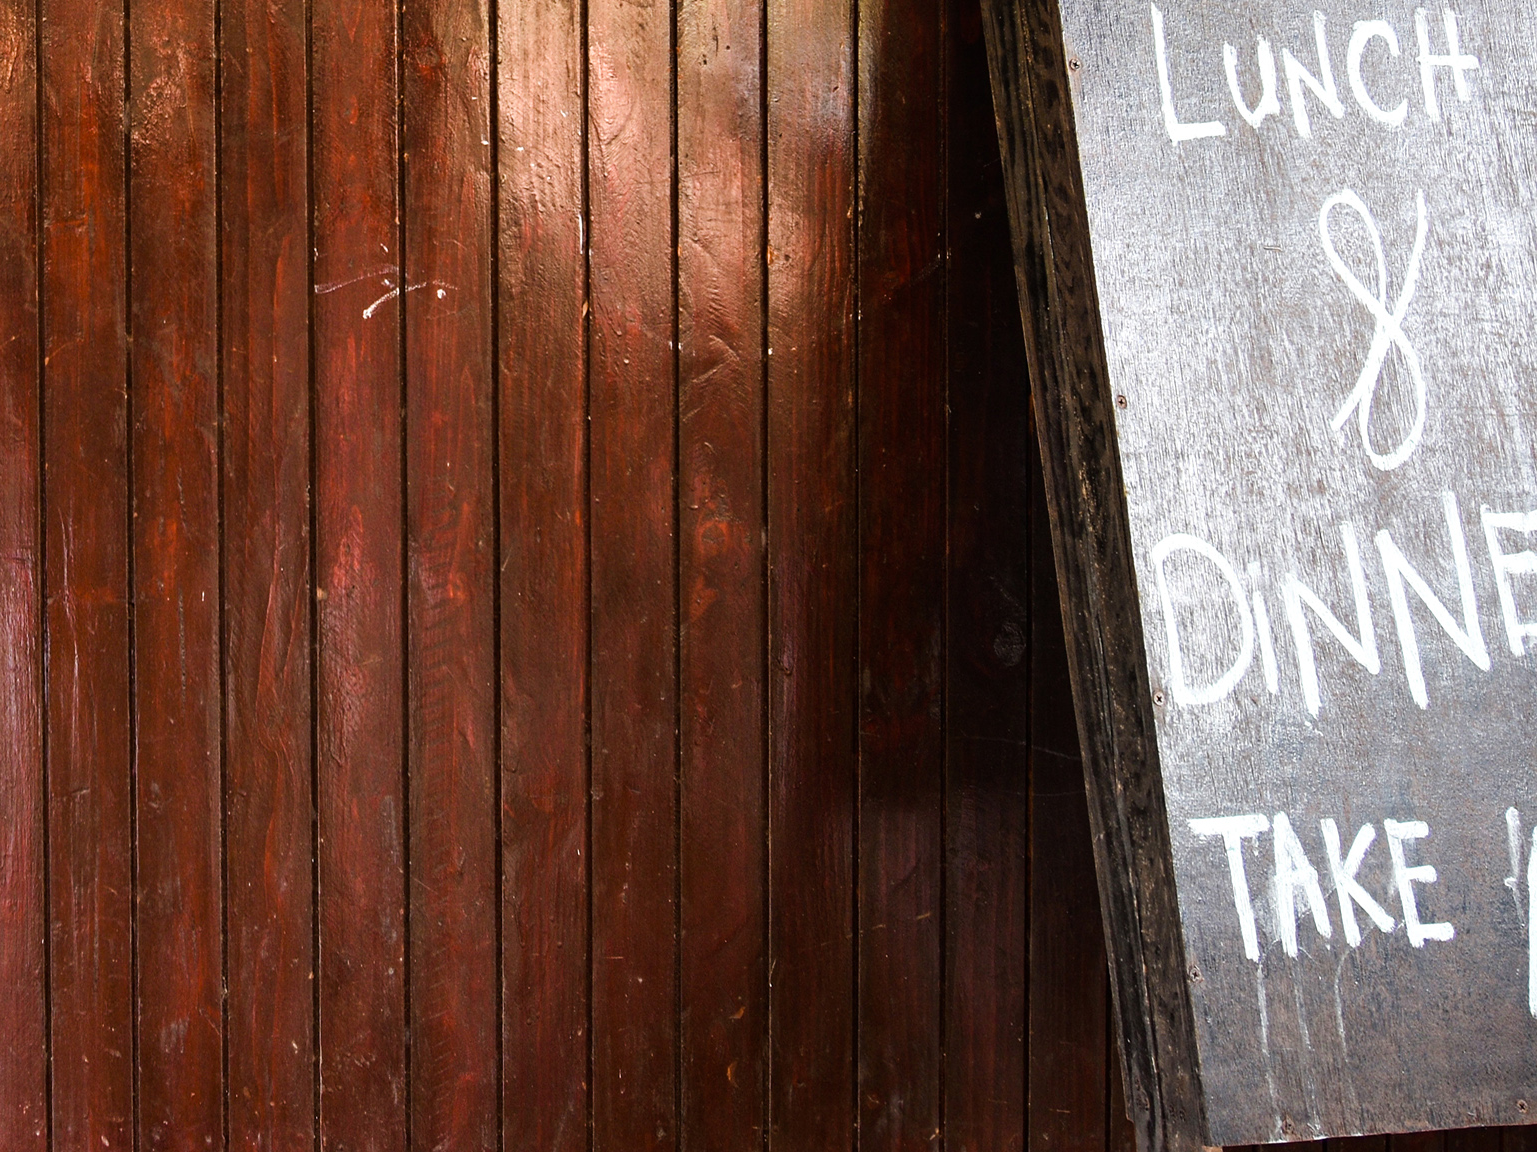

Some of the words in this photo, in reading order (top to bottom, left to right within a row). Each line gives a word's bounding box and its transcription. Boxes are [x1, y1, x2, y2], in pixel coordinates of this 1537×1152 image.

[1150, 0, 1480, 144] LUNCH
[1316, 187, 1429, 472] &
[1186, 810, 1456, 963] TAKE
